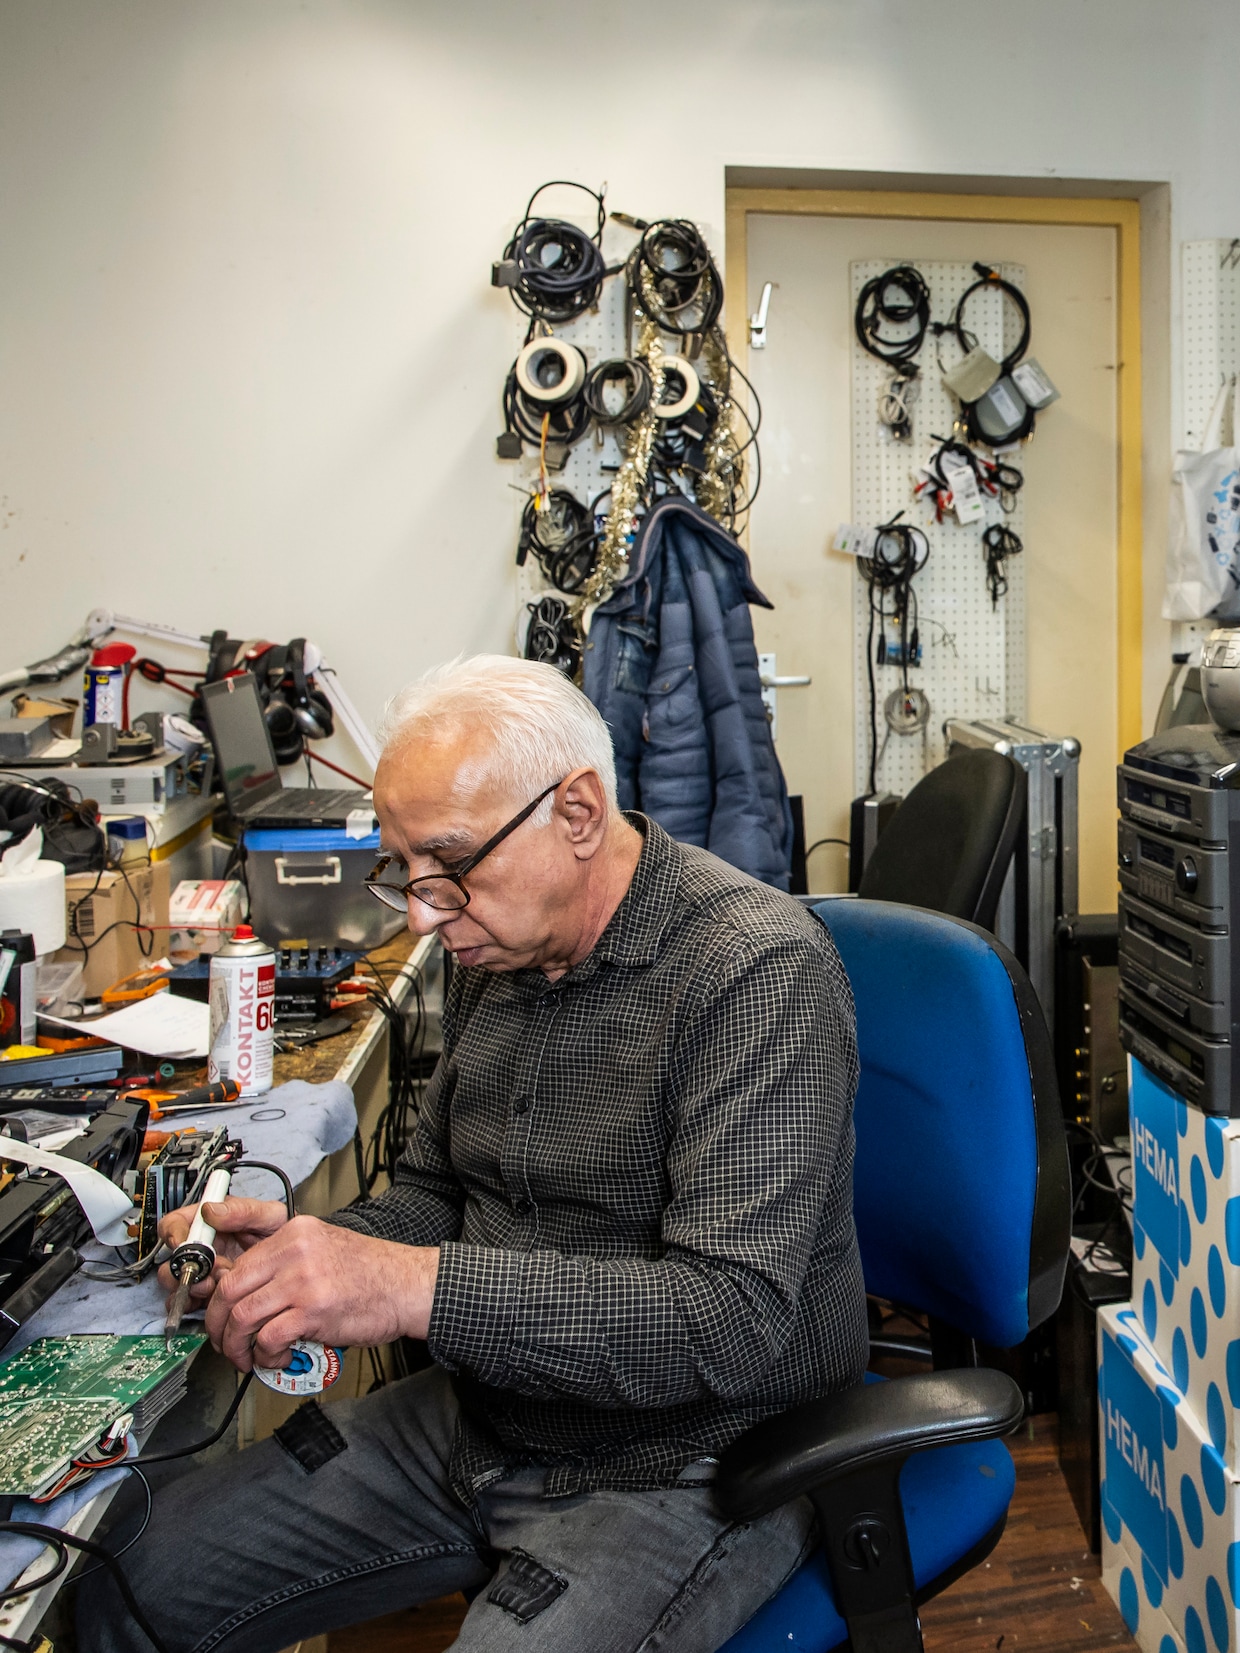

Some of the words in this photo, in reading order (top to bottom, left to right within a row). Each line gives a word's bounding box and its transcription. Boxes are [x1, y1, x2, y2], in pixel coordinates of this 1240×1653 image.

[236, 968, 255, 1088] KONTAKT
[1134, 1116, 1179, 1207] HEMA
[325, 1348, 339, 1382] STANNOL
[1107, 1398, 1164, 1512] HEMA
